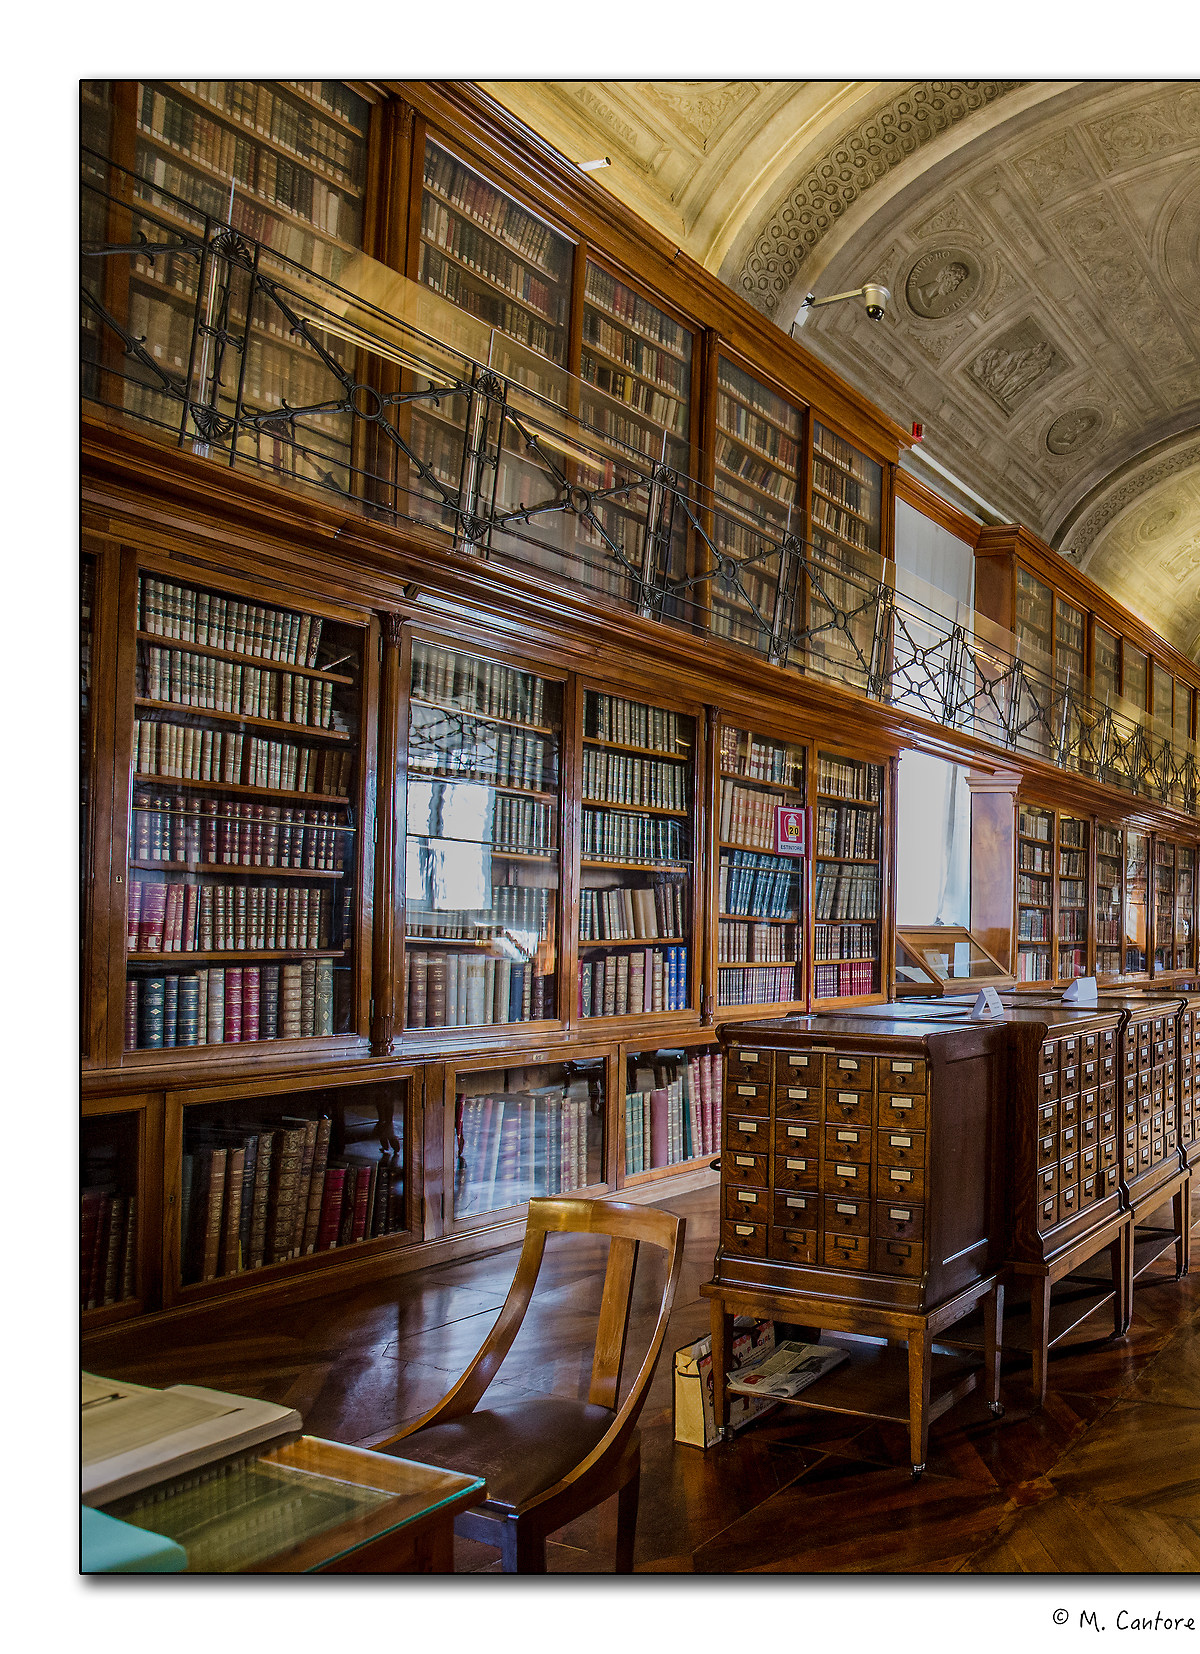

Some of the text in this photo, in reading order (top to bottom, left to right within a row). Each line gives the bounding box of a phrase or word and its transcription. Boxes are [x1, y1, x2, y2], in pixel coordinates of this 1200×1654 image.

[575, 88, 638, 146] AVICENNA
[908, 250, 952, 288] BERTERO
[789, 827, 799, 835] 20
